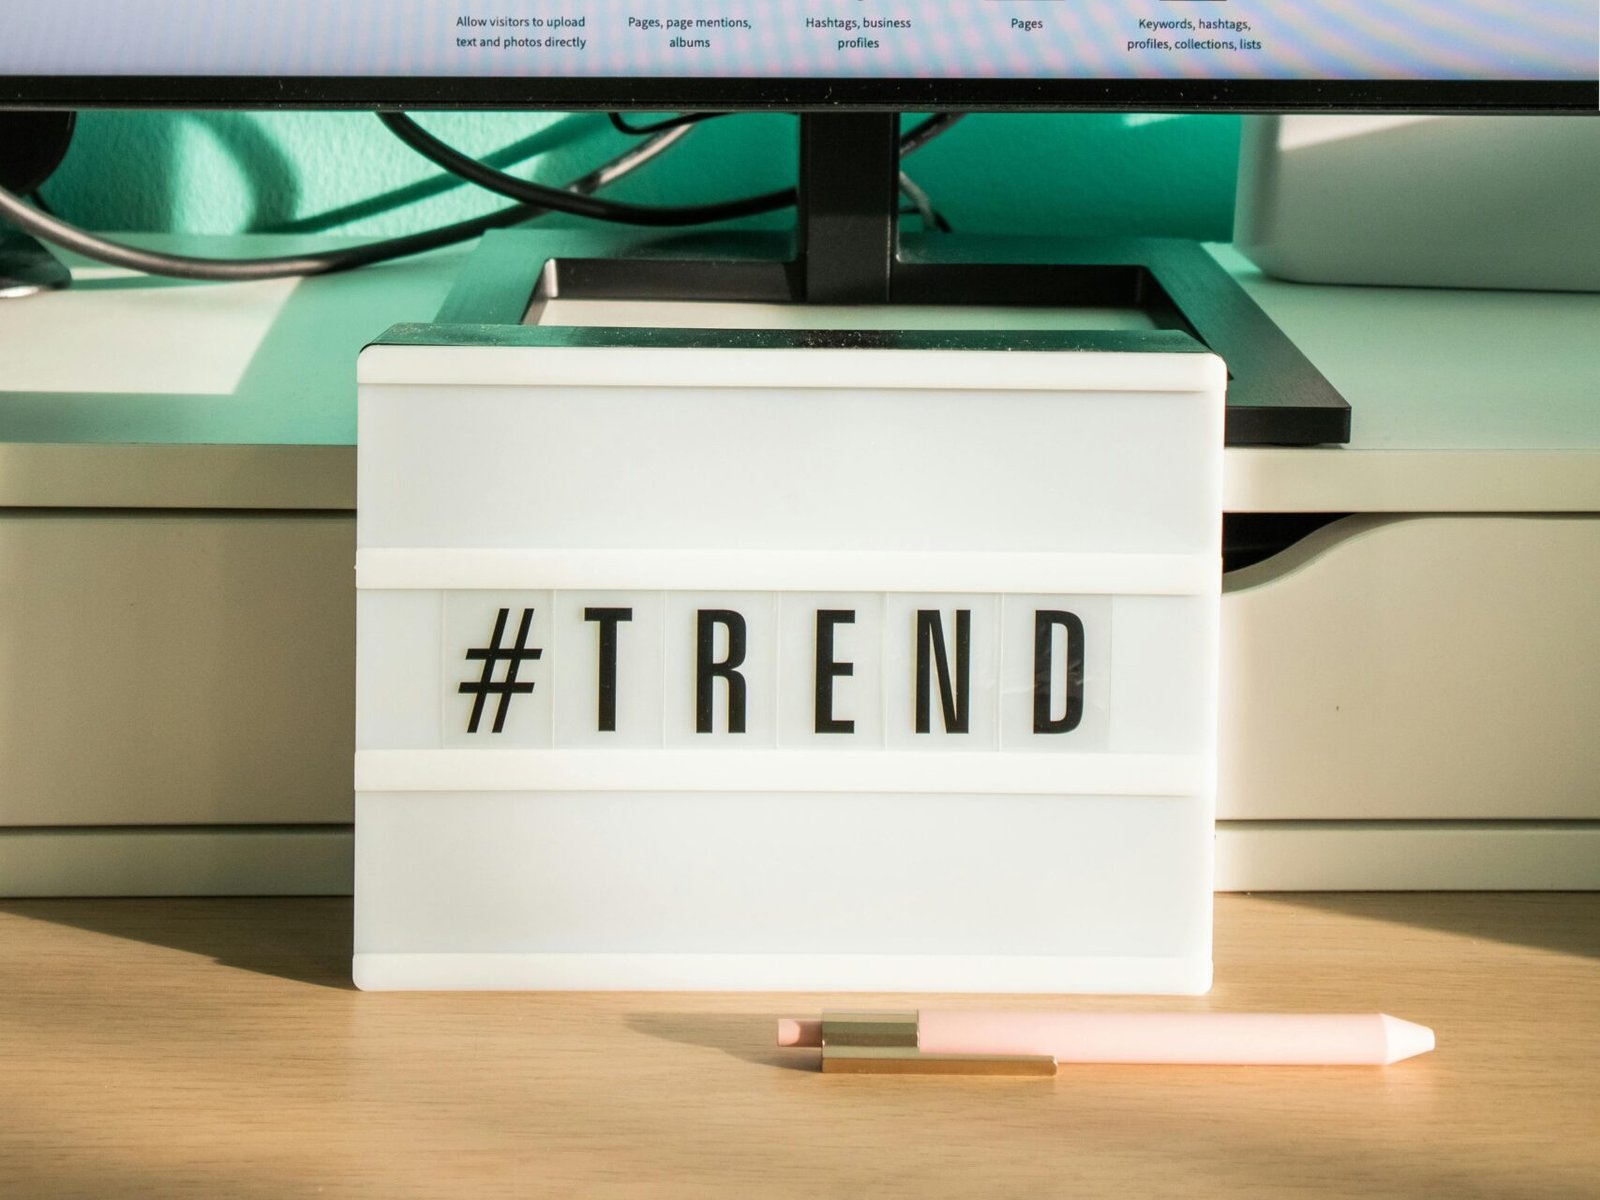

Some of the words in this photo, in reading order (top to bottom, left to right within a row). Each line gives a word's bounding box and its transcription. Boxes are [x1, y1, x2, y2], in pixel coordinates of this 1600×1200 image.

[455, 15, 488, 27] Allow
[489, 16, 530, 27] visitors
[531, 17, 544, 28] to
[546, 15, 586, 30] upload
[628, 16, 664, 31] Pages,
[666, 19, 694, 31] page
[695, 17, 752, 30] mentions,
[805, 16, 861, 31] Hashtags,
[862, 17, 912, 29] business
[1011, 17, 1043, 32] Pages
[1138, 17, 1196, 32] Keywords,
[1198, 17, 1251, 33] hashtags,
[455, 37, 477, 48] text
[479, 36, 501, 47] and
[503, 35, 543, 50] photos
[544, 36, 587, 51] directly
[669, 36, 711, 48] albums
[837, 36, 880, 51] profiles
[1127, 37, 1173, 52] profiles,
[1174, 38, 1237, 52] collections,
[1239, 38, 1262, 50] lists
[457, 607, 1086, 735] #TREND
